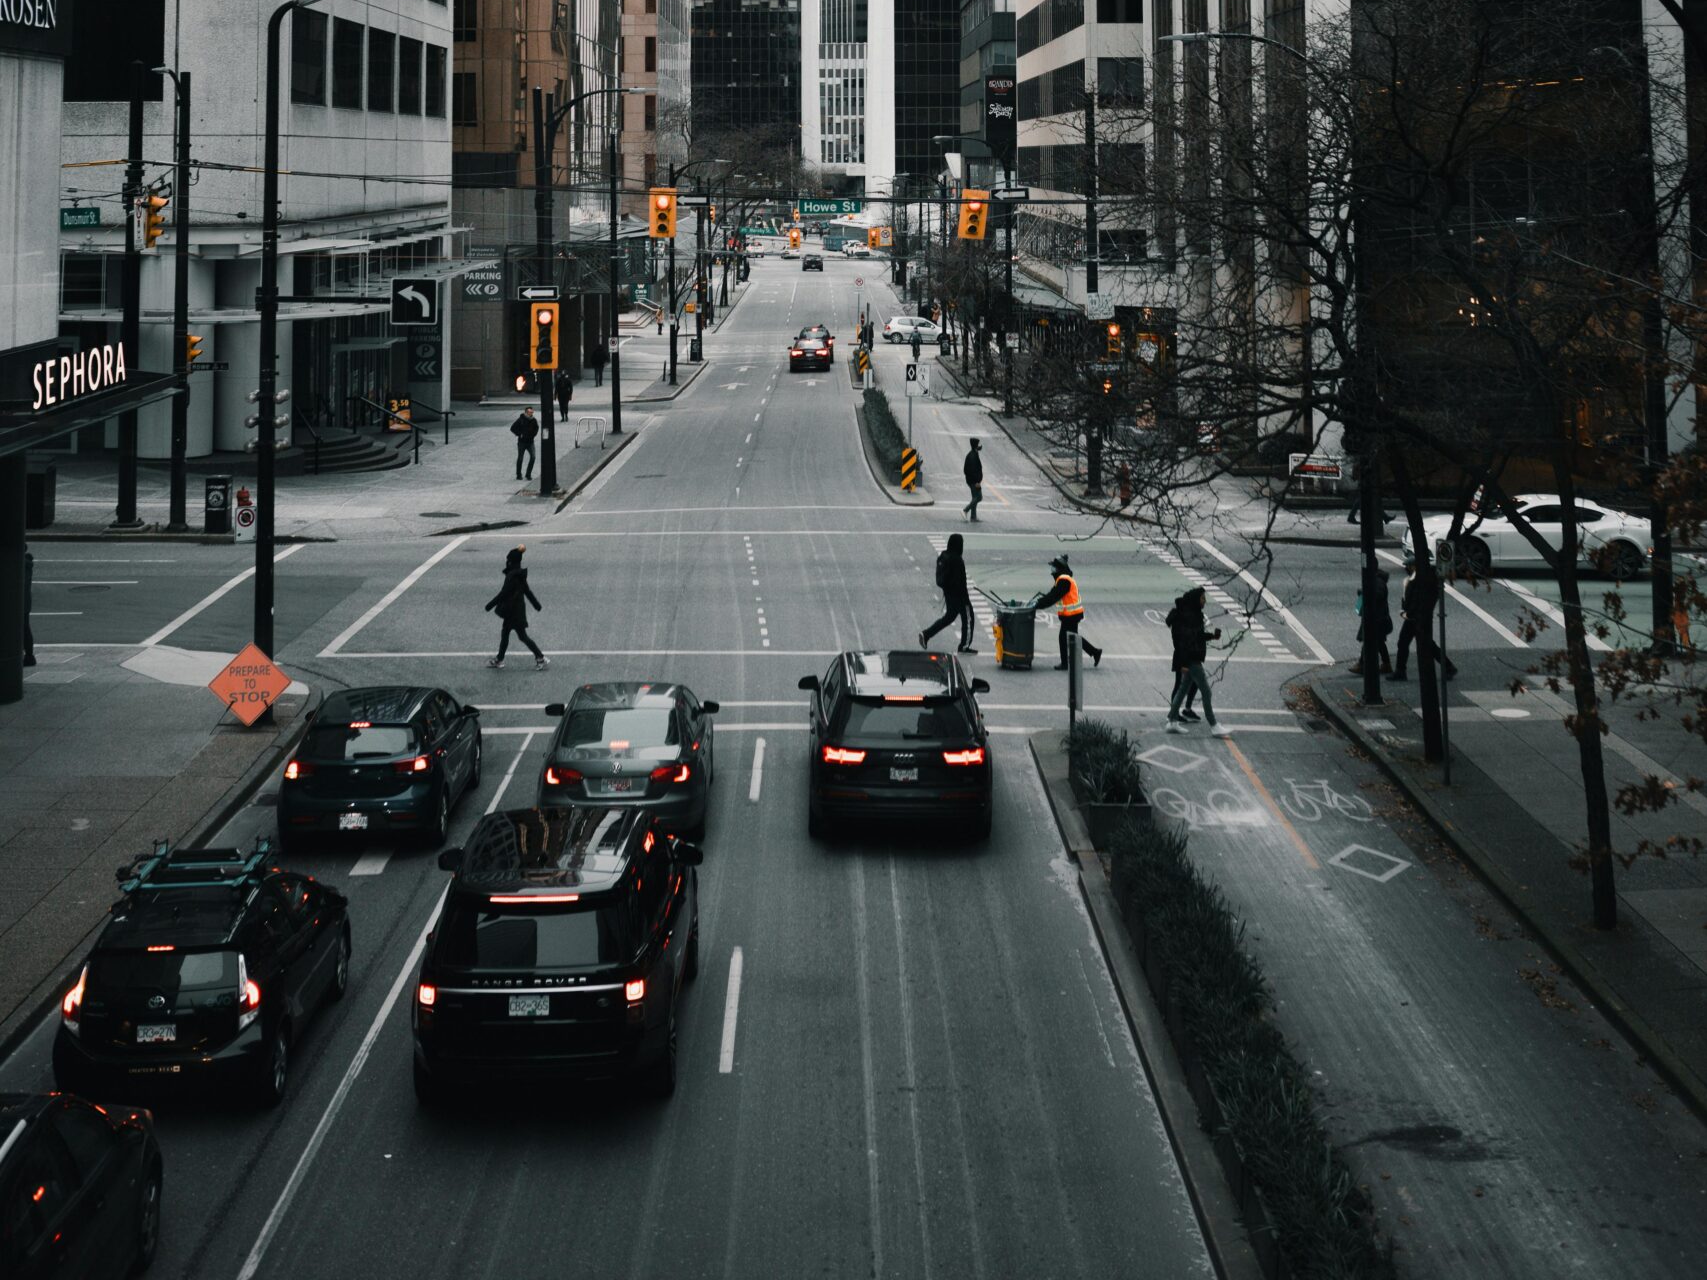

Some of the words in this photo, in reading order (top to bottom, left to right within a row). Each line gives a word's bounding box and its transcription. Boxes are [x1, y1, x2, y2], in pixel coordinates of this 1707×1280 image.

[804, 202, 837, 212] Howe
[842, 201, 856, 211] St
[63, 212, 90, 225] Dunsmuir
[464, 272, 502, 280] PARKING
[33, 341, 126, 410] SEPHORA
[229, 665, 271, 677] PREPARE
[243, 678, 256, 689] TO
[229, 691, 270, 703] STOP
